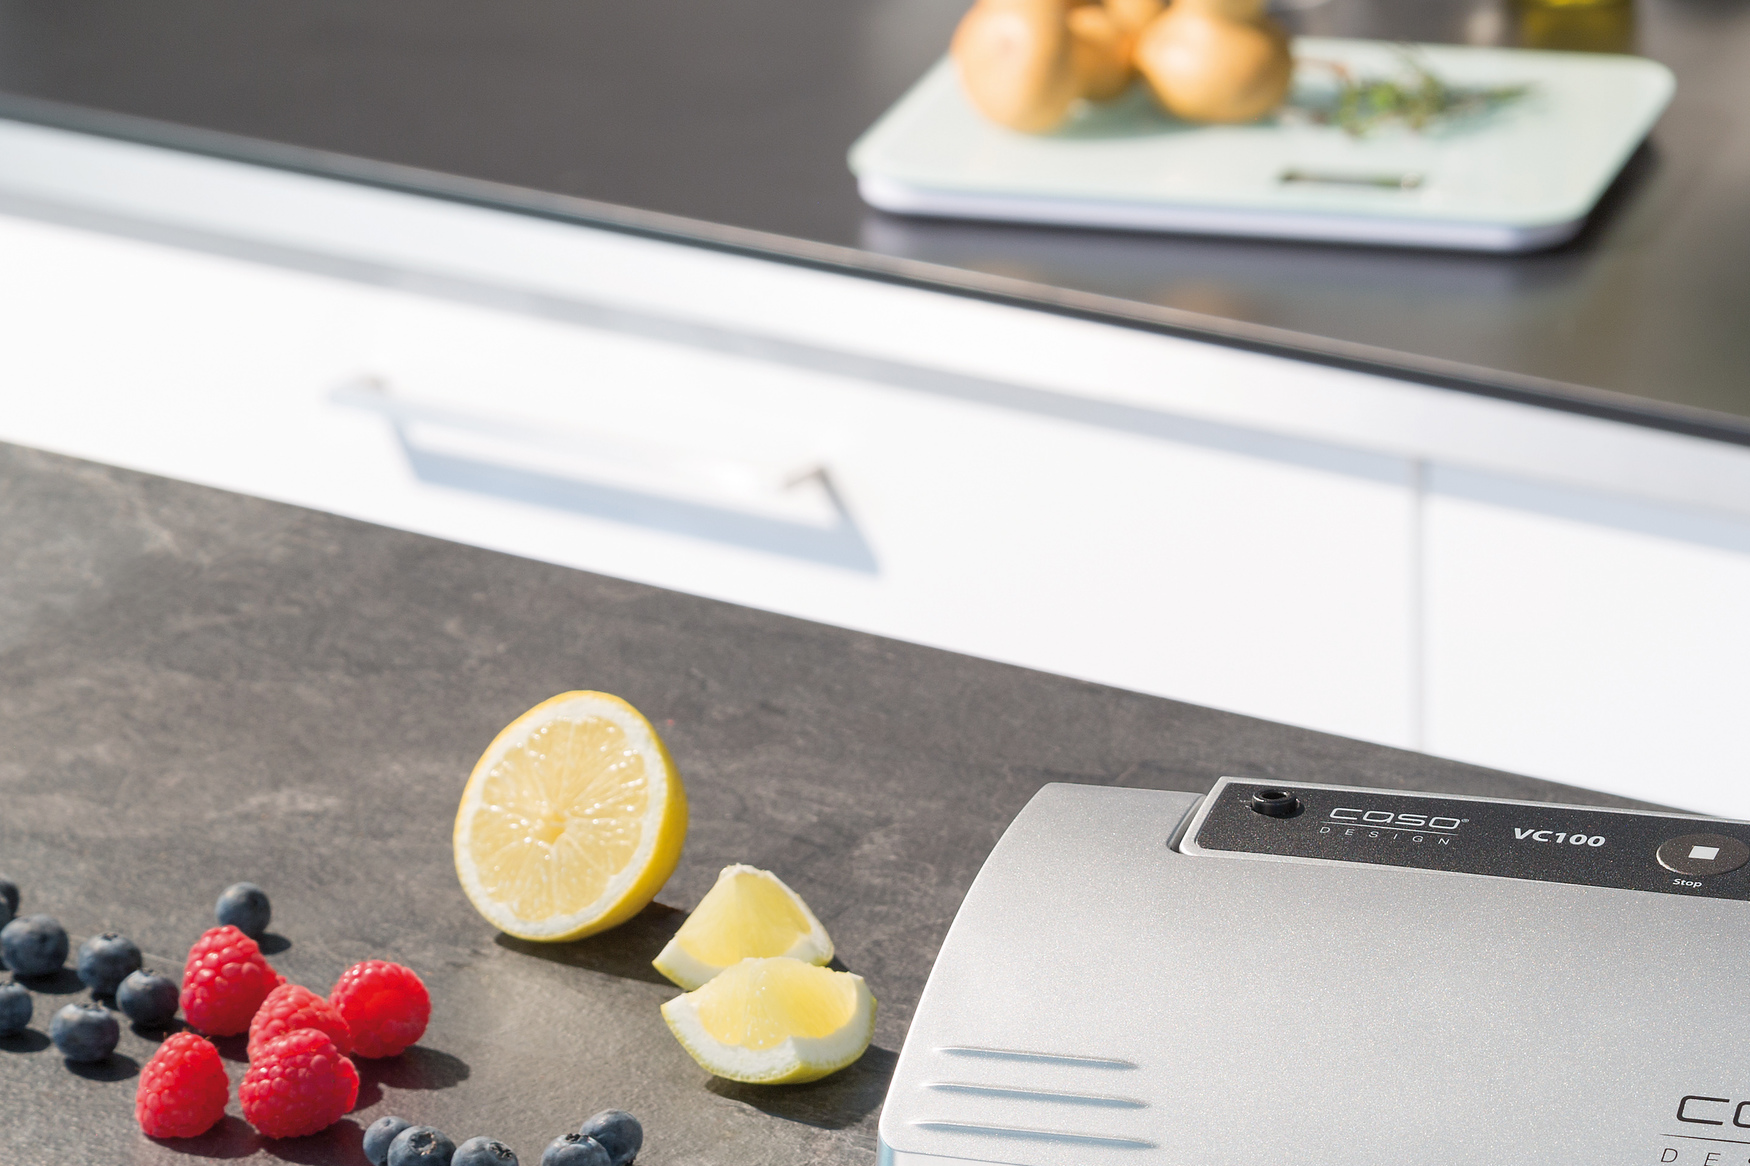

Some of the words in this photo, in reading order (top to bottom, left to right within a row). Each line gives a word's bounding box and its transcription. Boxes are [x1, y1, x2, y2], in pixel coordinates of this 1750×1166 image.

[1319, 826, 1450, 845] DESIGN
[1514, 827, 1606, 847] VC100
[1672, 878, 1703, 888] Stop
